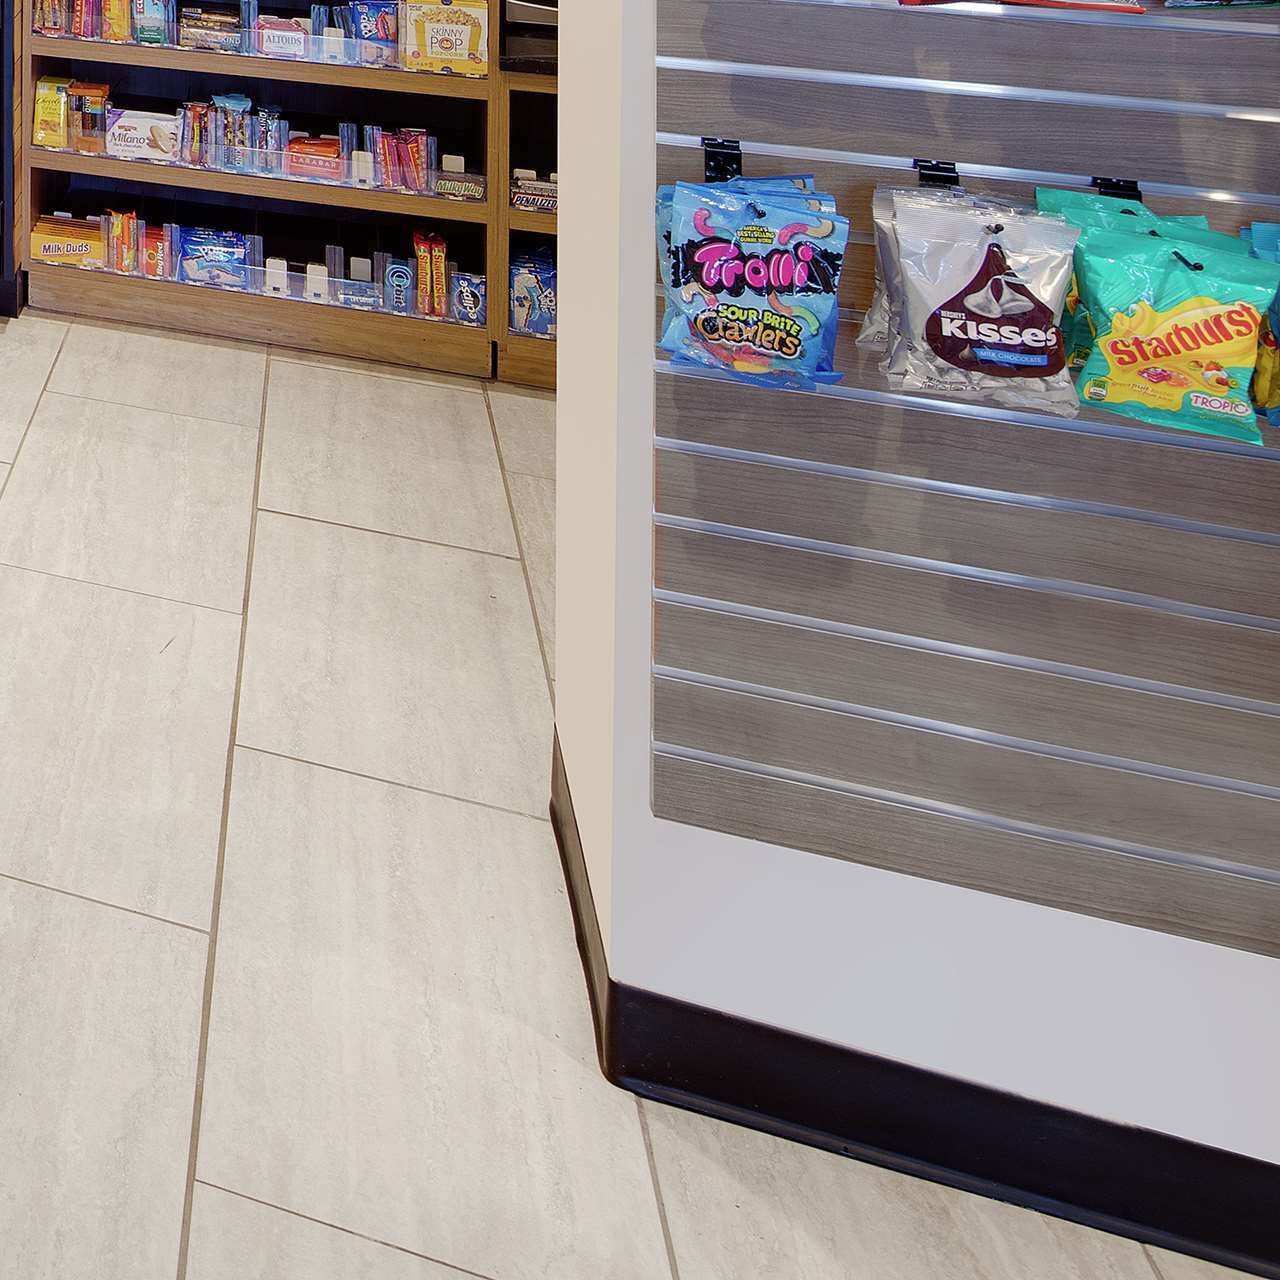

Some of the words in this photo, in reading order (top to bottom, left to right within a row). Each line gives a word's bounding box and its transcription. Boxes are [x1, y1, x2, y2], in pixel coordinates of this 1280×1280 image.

[431, 26, 464, 37] SKINNY
[265, 33, 302, 47] ALTOIDS
[430, 36, 464, 52] POP
[110, 131, 146, 145] Milano
[291, 155, 338, 169] LARABAR
[435, 179, 463, 195] Milky
[461, 182, 485, 198] Way
[42, 243, 63, 255] Milk
[64, 242, 89, 253] Duds
[693, 241, 814, 289] Trolli
[460, 279, 477, 319] eclipse
[718, 304, 761, 321] SOUR
[763, 310, 803, 338] BRITE
[694, 310, 802, 357] Crawlers
[1108, 300, 1262, 367] Starburst
[979, 350, 997, 359] MILK
[997, 351, 1043, 363] CHOCOLATE
